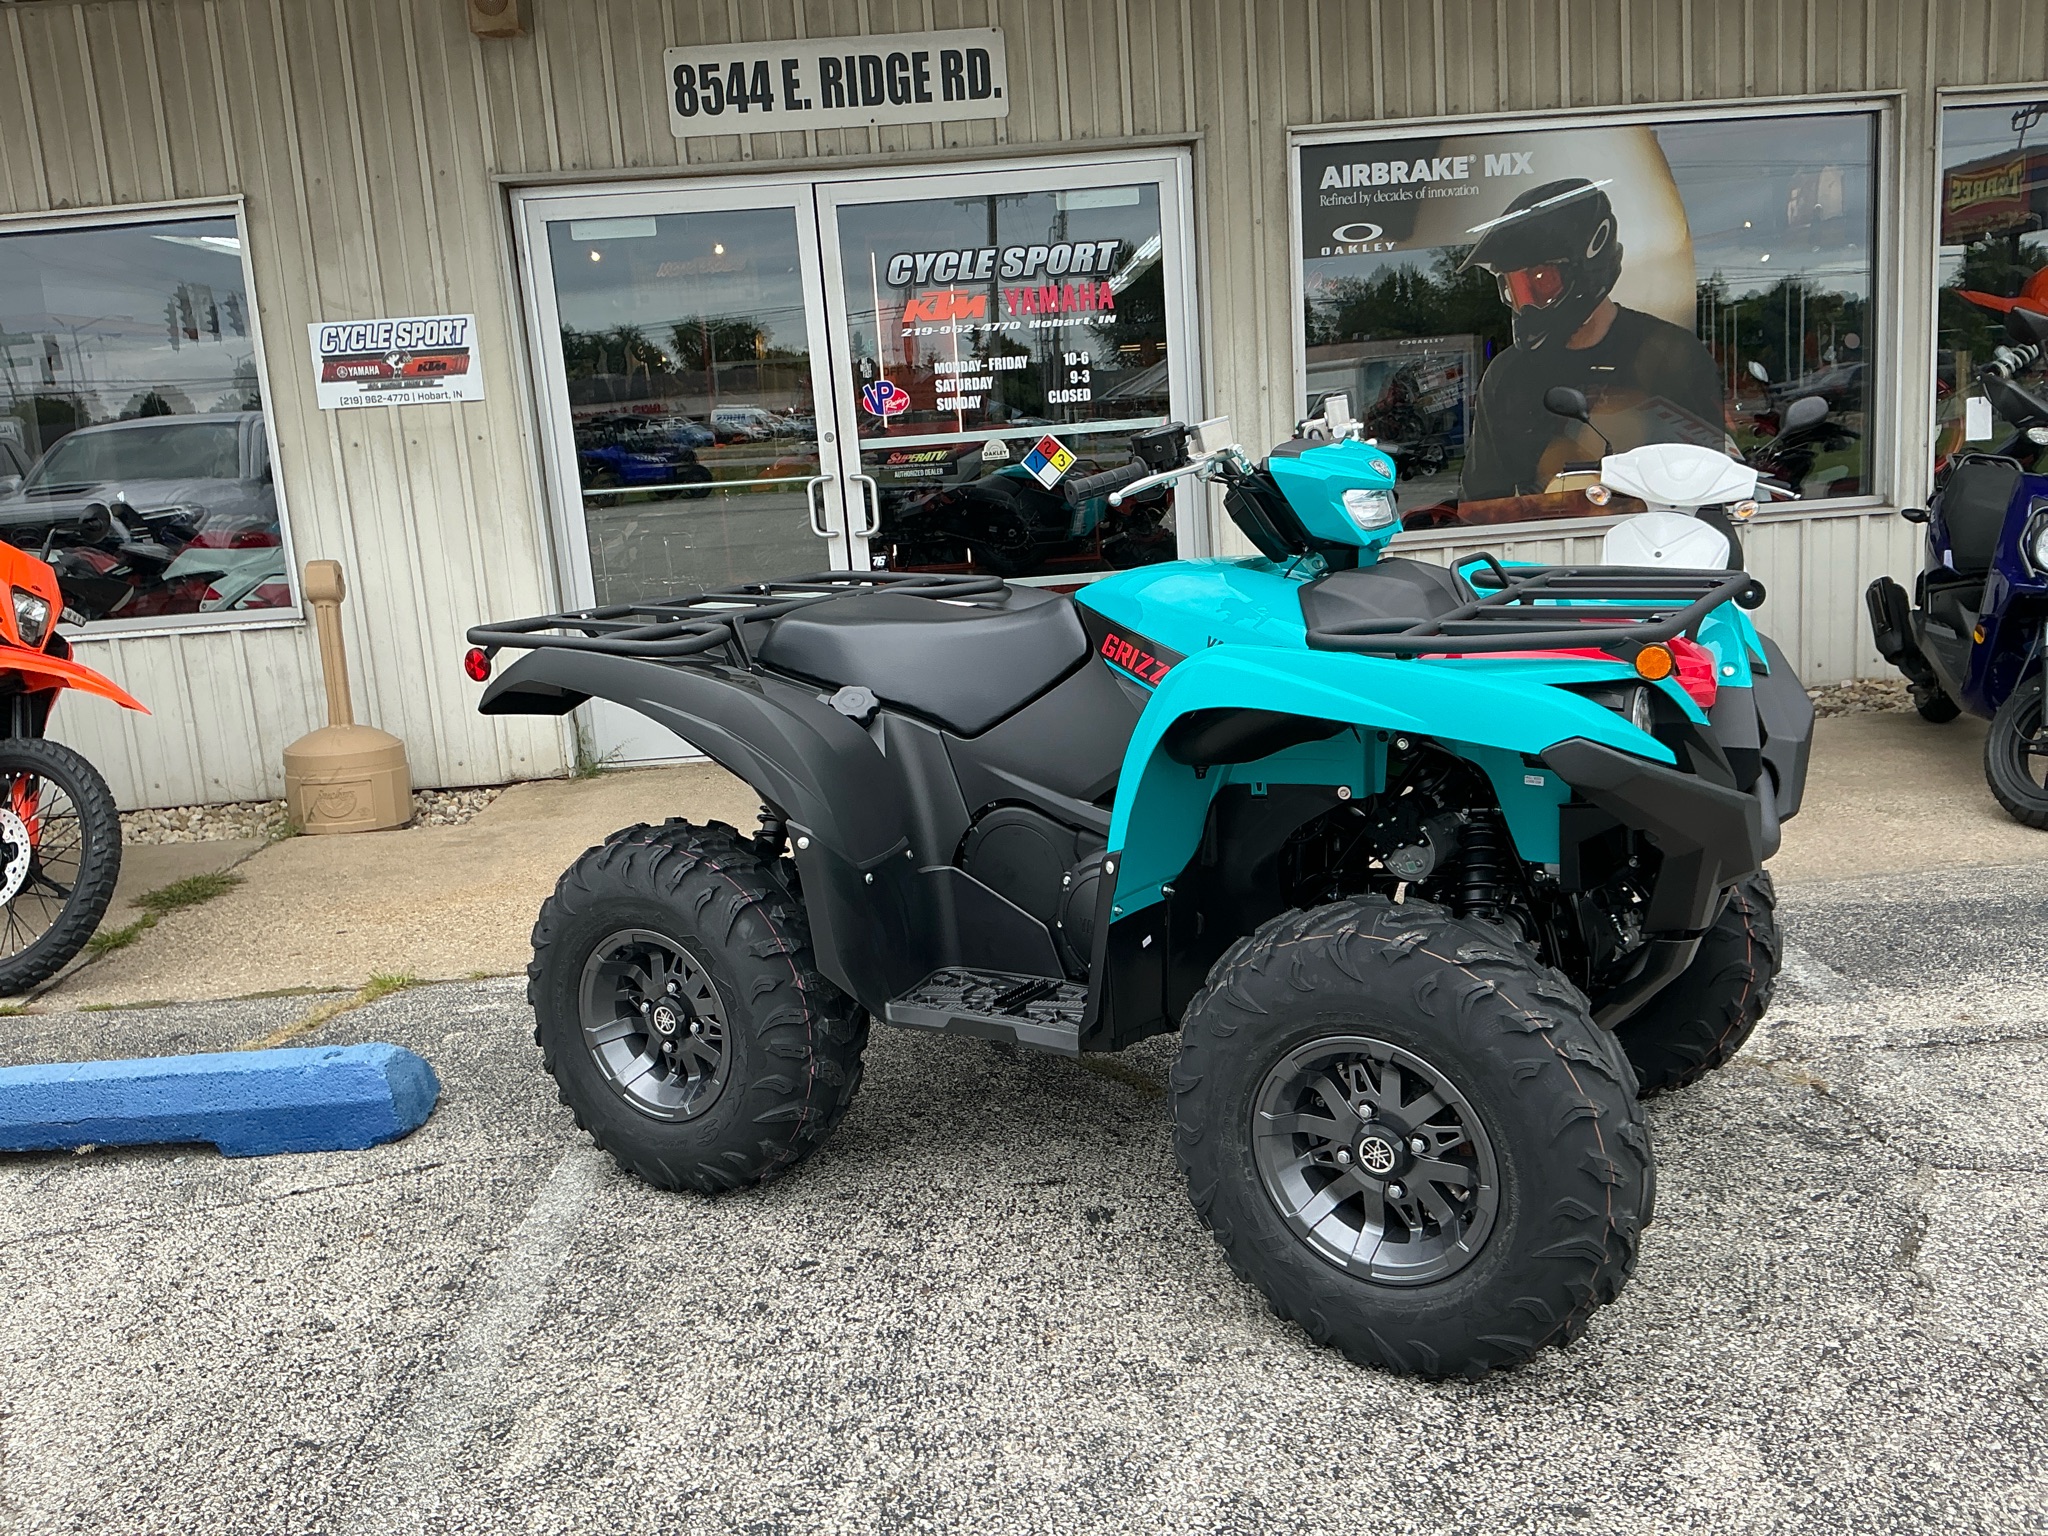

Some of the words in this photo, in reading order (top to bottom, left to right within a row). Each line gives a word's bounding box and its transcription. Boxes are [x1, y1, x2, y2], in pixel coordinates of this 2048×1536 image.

[673, 60, 774, 117] 8544
[781, 58, 812, 111] E.
[818, 51, 932, 109] RIDGE
[940, 48, 1003, 102] RD.
[1484, 151, 1535, 177] MX
[1319, 191, 1357, 207] Refined
[1359, 190, 1371, 205] by
[1373, 188, 1413, 203] decades
[1415, 186, 1427, 199] of
[1427, 184, 1480, 198] innovation
[1321, 241, 1396, 256] OAKLEY
[887, 247, 998, 288] CYCLE
[1000, 239, 1122, 281] SPORT
[902, 289, 987, 323] KTM
[1004, 282, 1115, 316] YAMAHA
[320, 323, 393, 353] CYCLE
[395, 318, 467, 348] SPORT
[901, 321, 1021, 338] 219-962-4770
[1028, 316, 1095, 329] Hobart,
[1098, 315, 1117, 325] IN
[417, 361, 447, 372] KTM
[1063, 352, 1088, 366] 10-6
[348, 365, 380, 376] YAMAHA
[935, 376, 993, 393] SATURDAY
[1070, 370, 1090, 383] 9-3
[340, 395, 363, 406] (219)
[365, 393, 409, 404] 962-4770
[418, 391, 451, 401] Hobart,
[453, 390, 463, 399] IN
[863, 381, 894, 415] VP
[936, 395, 982, 411] SUNDAY
[1048, 389, 1091, 404] CLOSED
[1043, 440, 1052, 455] 2
[1058, 454, 1067, 467] 3
[894, 469, 925, 478] AUTHORIZED
[925, 468, 944, 477] DEALER
[872, 556, 887, 566] 76
